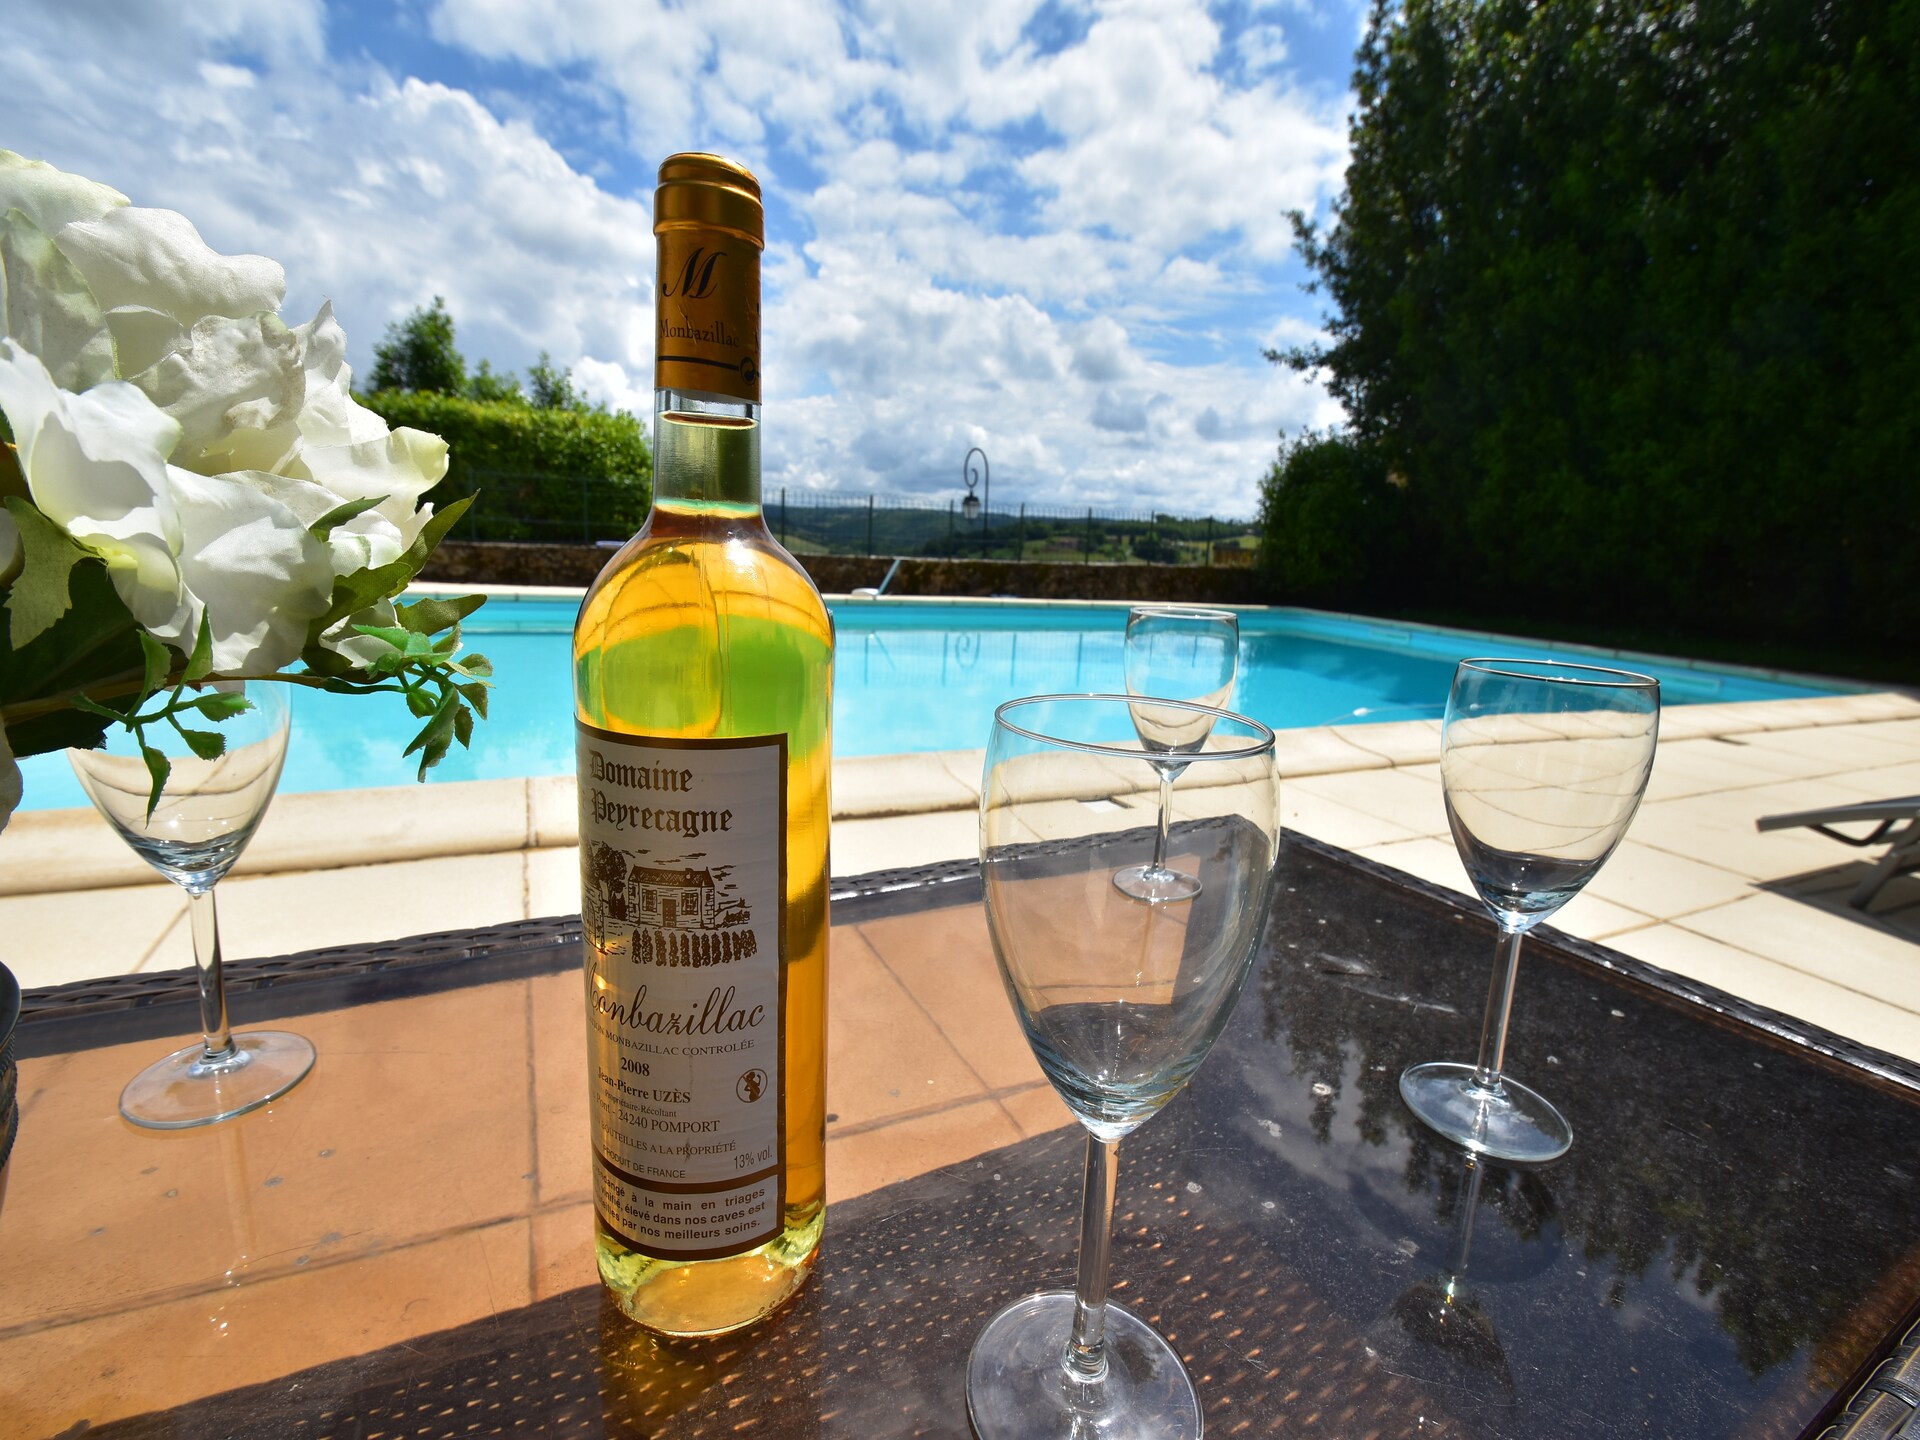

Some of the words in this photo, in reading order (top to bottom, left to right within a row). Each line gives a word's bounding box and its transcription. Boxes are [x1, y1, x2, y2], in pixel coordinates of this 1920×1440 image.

[662, 247, 726, 298] M
[660, 315, 739, 347] Monbazillac
[588, 748, 693, 792] Domaine
[606, 1030, 679, 1056] MONBAZILLAC
[683, 1039, 755, 1056] CONTROLÉE
[621, 1057, 650, 1077] 2008
[598, 1066, 649, 1100] Jean-Pierre
[653, 1088, 691, 1104] UZÈS
[618, 1109, 648, 1129] 24240
[651, 1120, 720, 1133] POMPORT
[657, 1145, 674, 1155] LA
[676, 1140, 736, 1156] PROPRIÉTÉ
[734, 1152, 754, 1169] 13%
[757, 1145, 773, 1163] vol.
[633, 1163, 644, 1173] DE
[647, 1167, 686, 1179] FRANCE
[631, 1192, 637, 1202] à
[644, 1196, 654, 1208] la
[662, 1200, 692, 1211] main
[701, 1201, 716, 1210] en
[725, 1187, 765, 1207] triages
[625, 1204, 650, 1221] élevé
[653, 1213, 681, 1225] dans
[684, 1216, 707, 1225] nos
[710, 1210, 745, 1224] caves
[748, 1202, 765, 1215] est
[622, 1215, 637, 1230] par
[640, 1225, 660, 1238] nos
[664, 1227, 720, 1240] meilleurs
[725, 1220, 760, 1236] soins.
